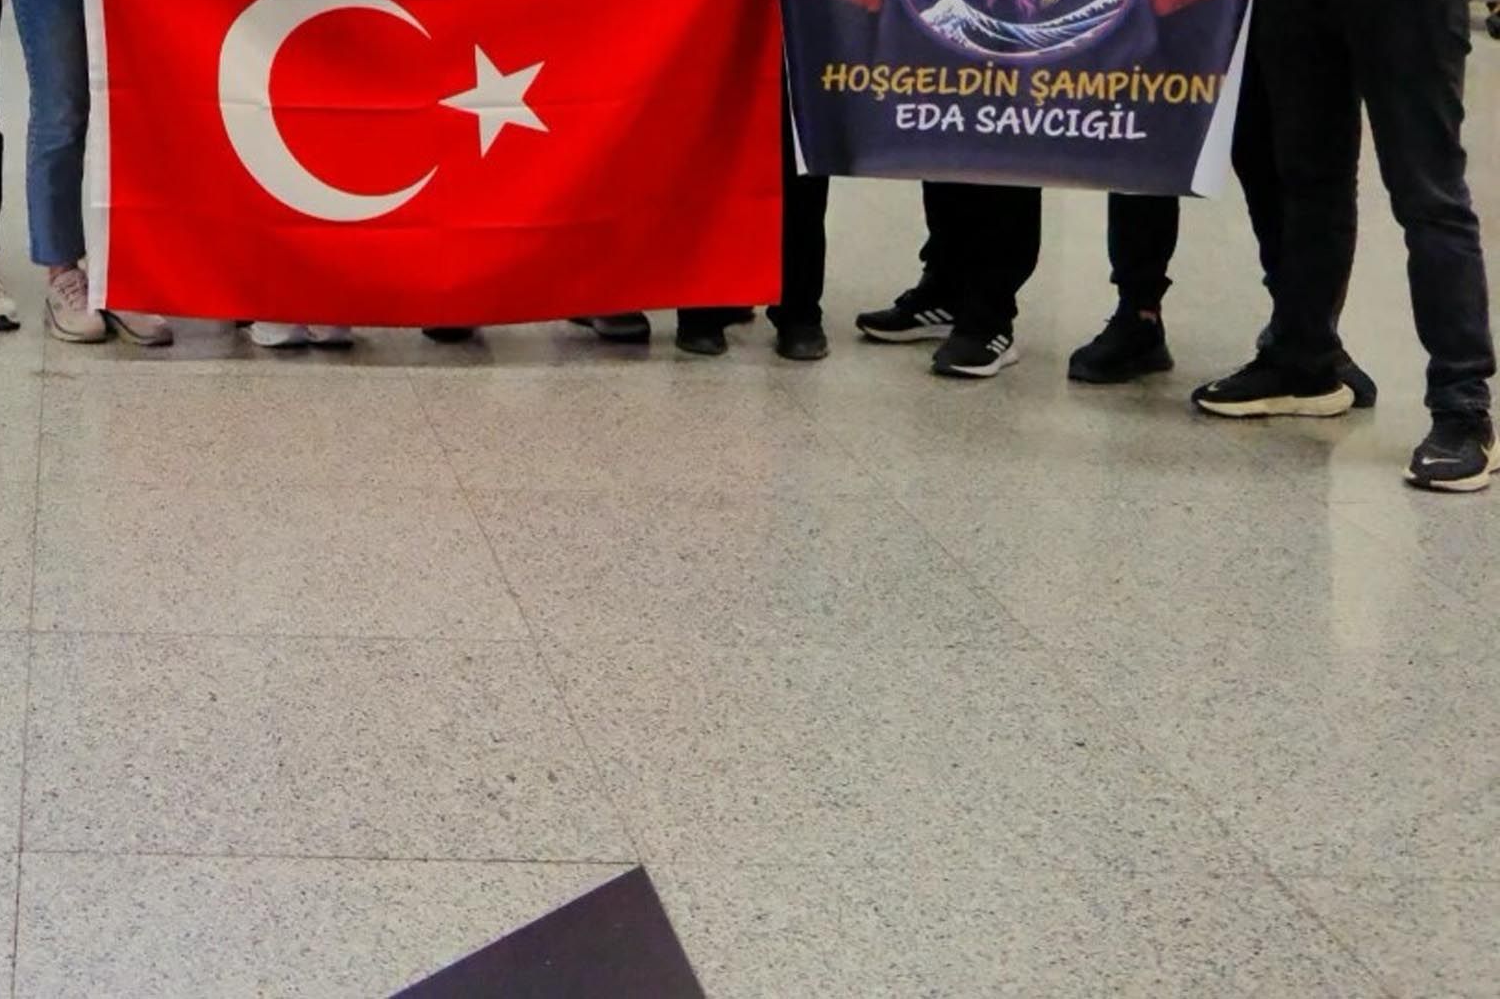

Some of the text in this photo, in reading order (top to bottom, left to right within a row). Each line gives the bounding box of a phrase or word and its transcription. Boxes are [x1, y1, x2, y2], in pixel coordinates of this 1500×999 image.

[821, 61, 1019, 101] HOŞGELDİN
[895, 102, 1147, 141] EDA SAVCIGİL
